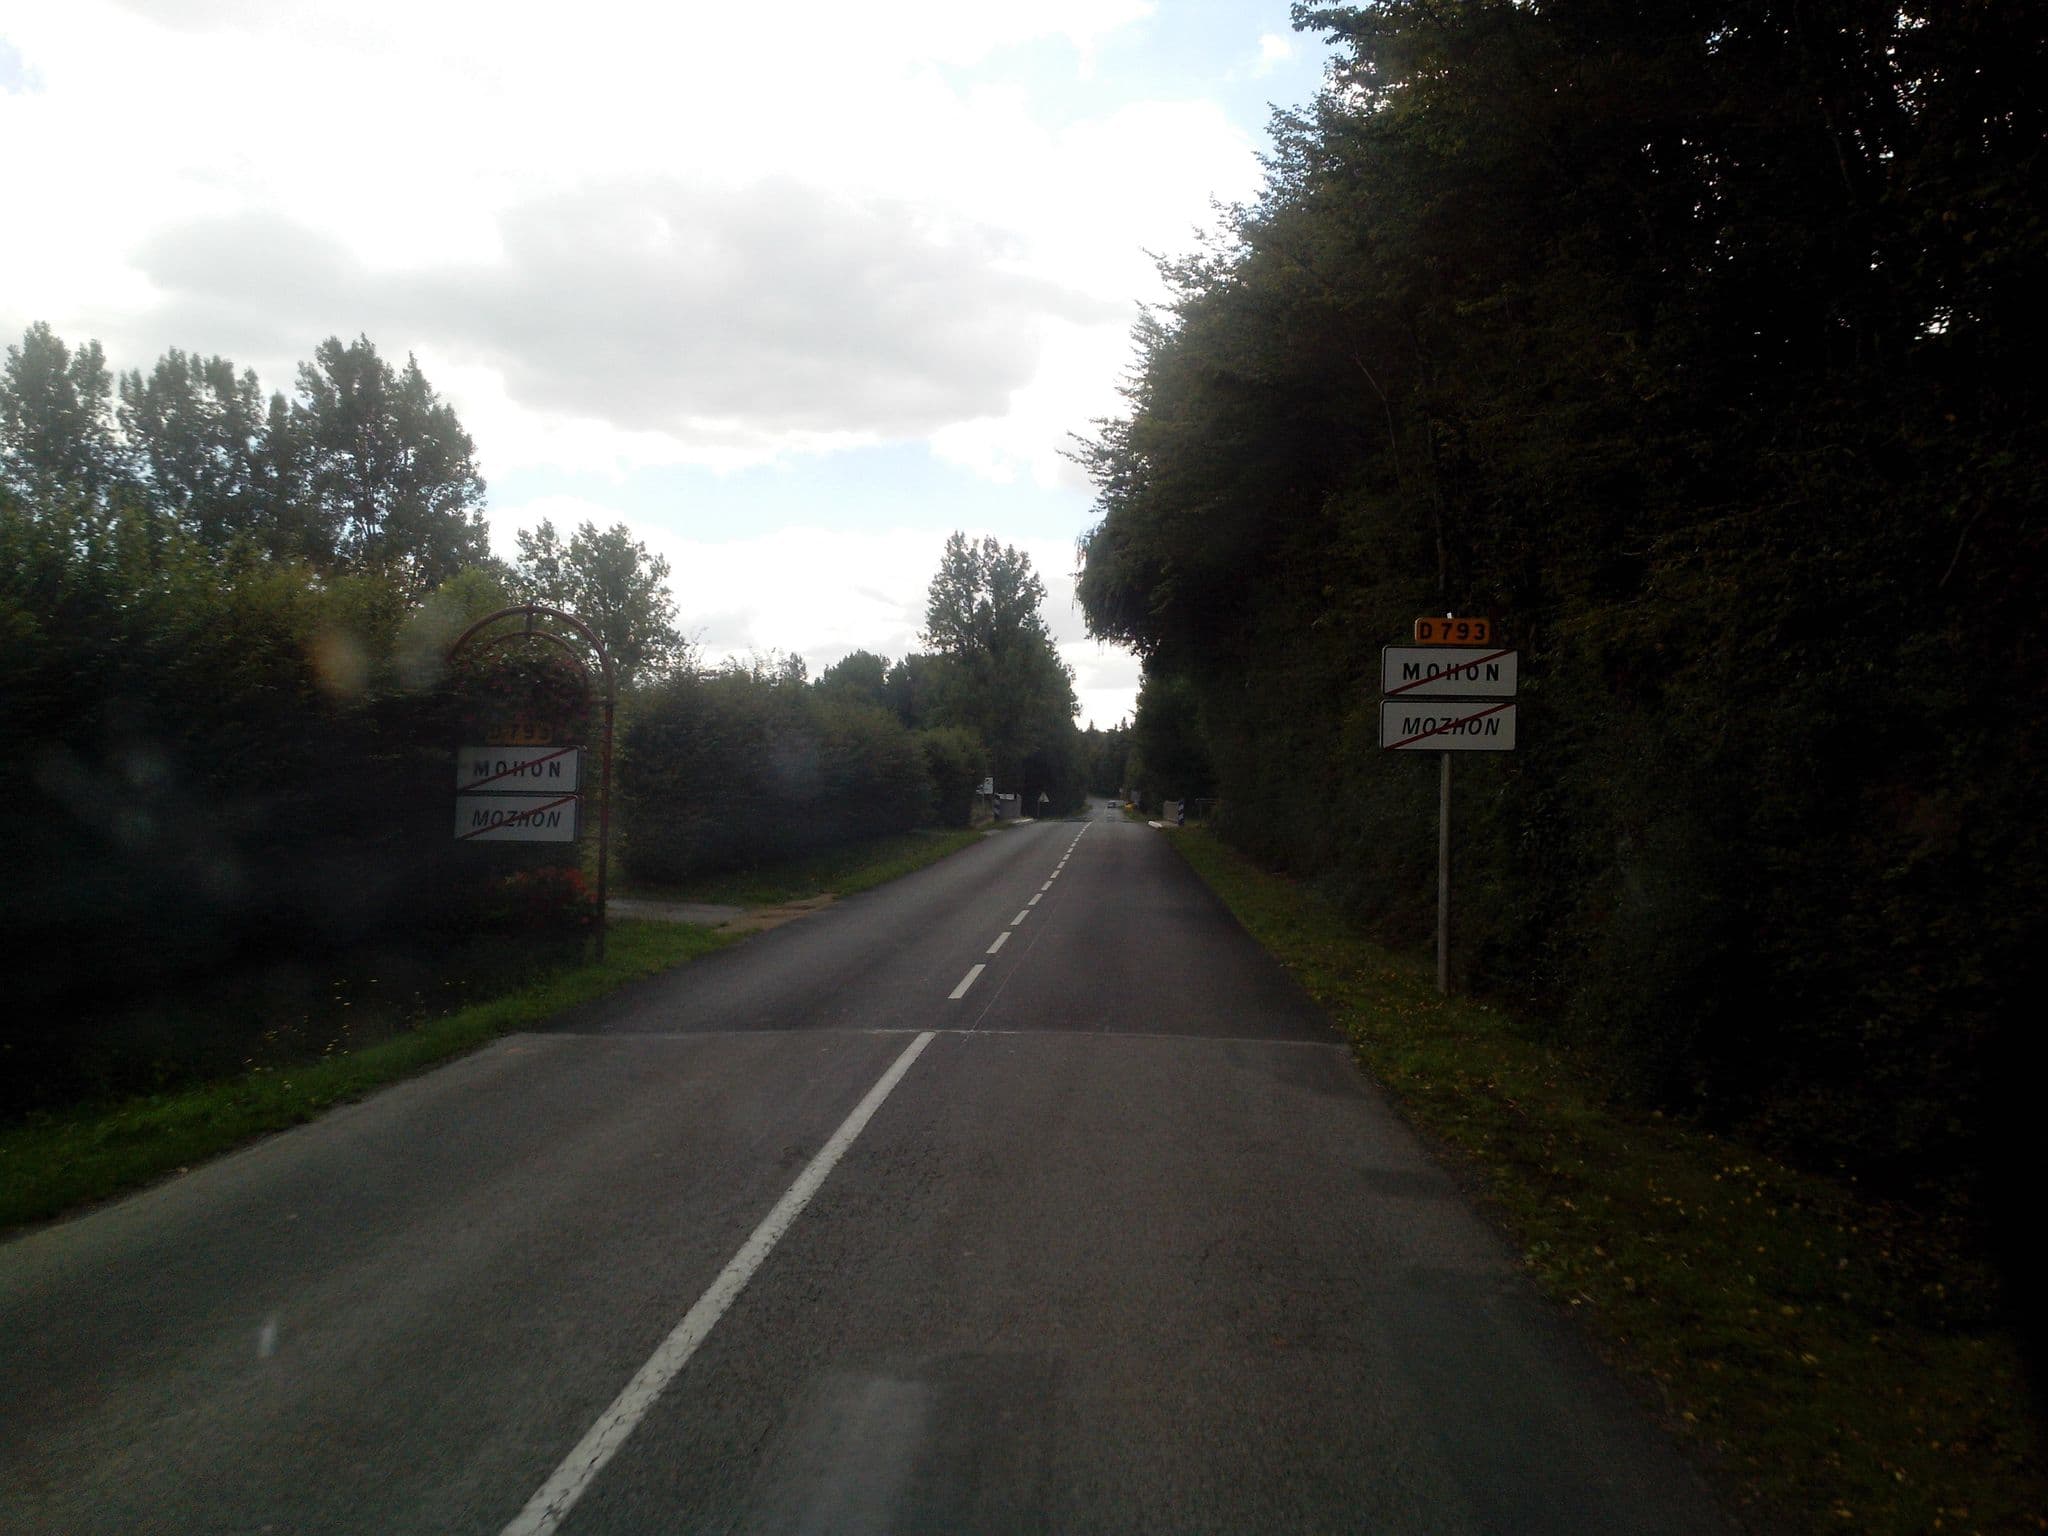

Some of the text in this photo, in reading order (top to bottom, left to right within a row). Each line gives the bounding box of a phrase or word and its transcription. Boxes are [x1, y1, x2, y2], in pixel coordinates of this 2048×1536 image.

[1419, 622, 1486, 640] D 793
[1403, 662, 1499, 681] MOHON
[1402, 717, 1500, 736] MOZHON
[474, 760, 561, 777] MOHON
[472, 809, 561, 828] MOZHON
